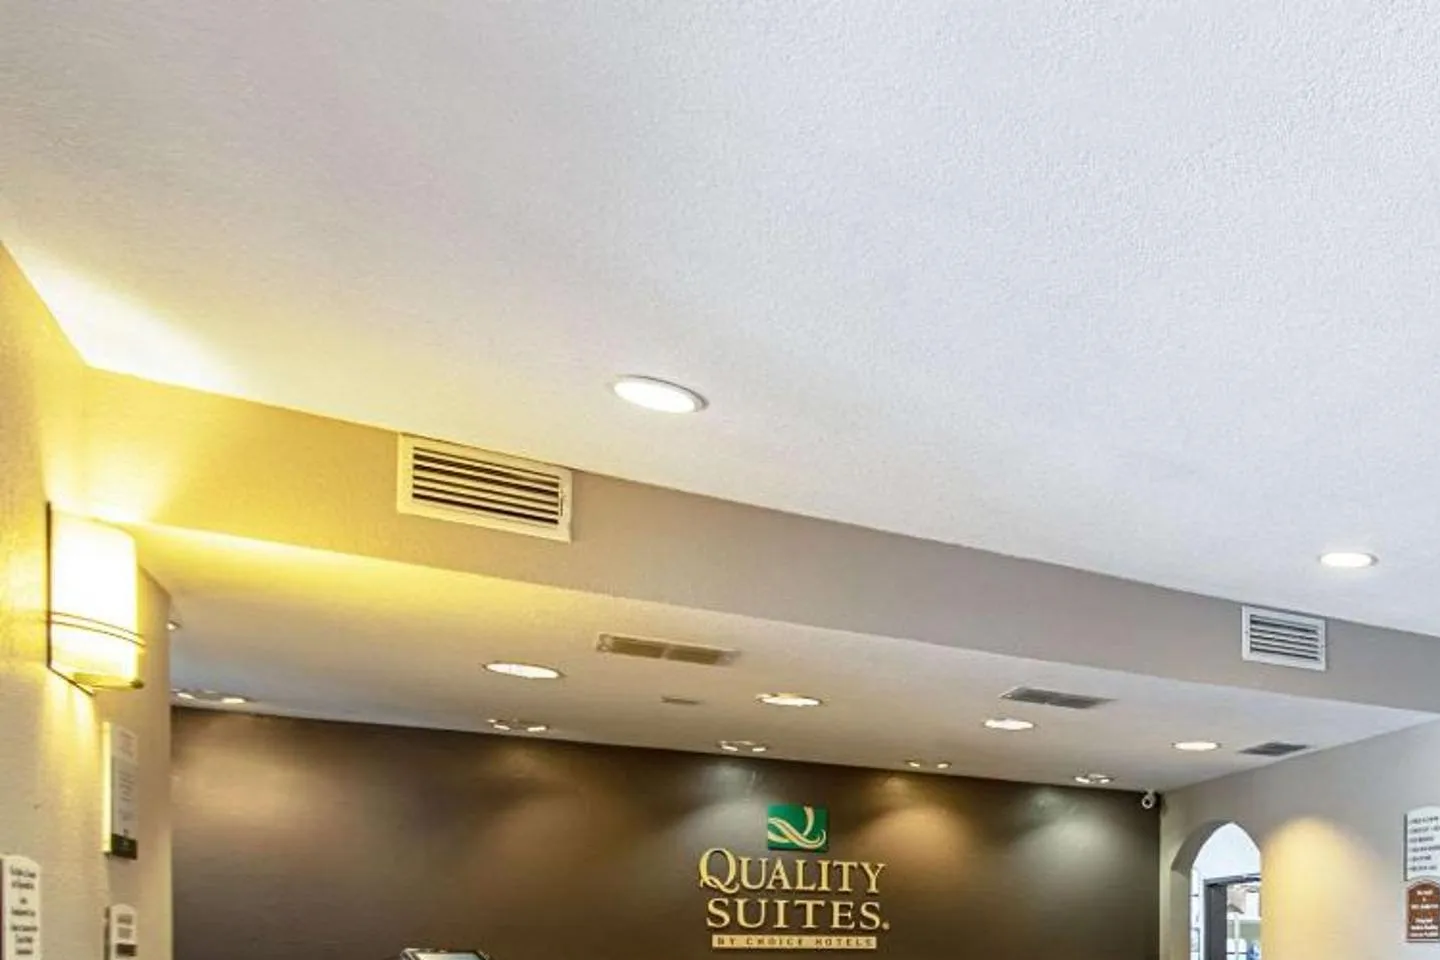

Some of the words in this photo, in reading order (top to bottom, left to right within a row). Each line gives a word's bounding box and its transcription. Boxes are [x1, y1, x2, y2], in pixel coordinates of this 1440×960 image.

[699, 848, 886, 894] QUALITY
[717, 936, 736, 946] BY
[746, 936, 804, 946] CHOICE
[815, 937, 874, 947] HOTELS
